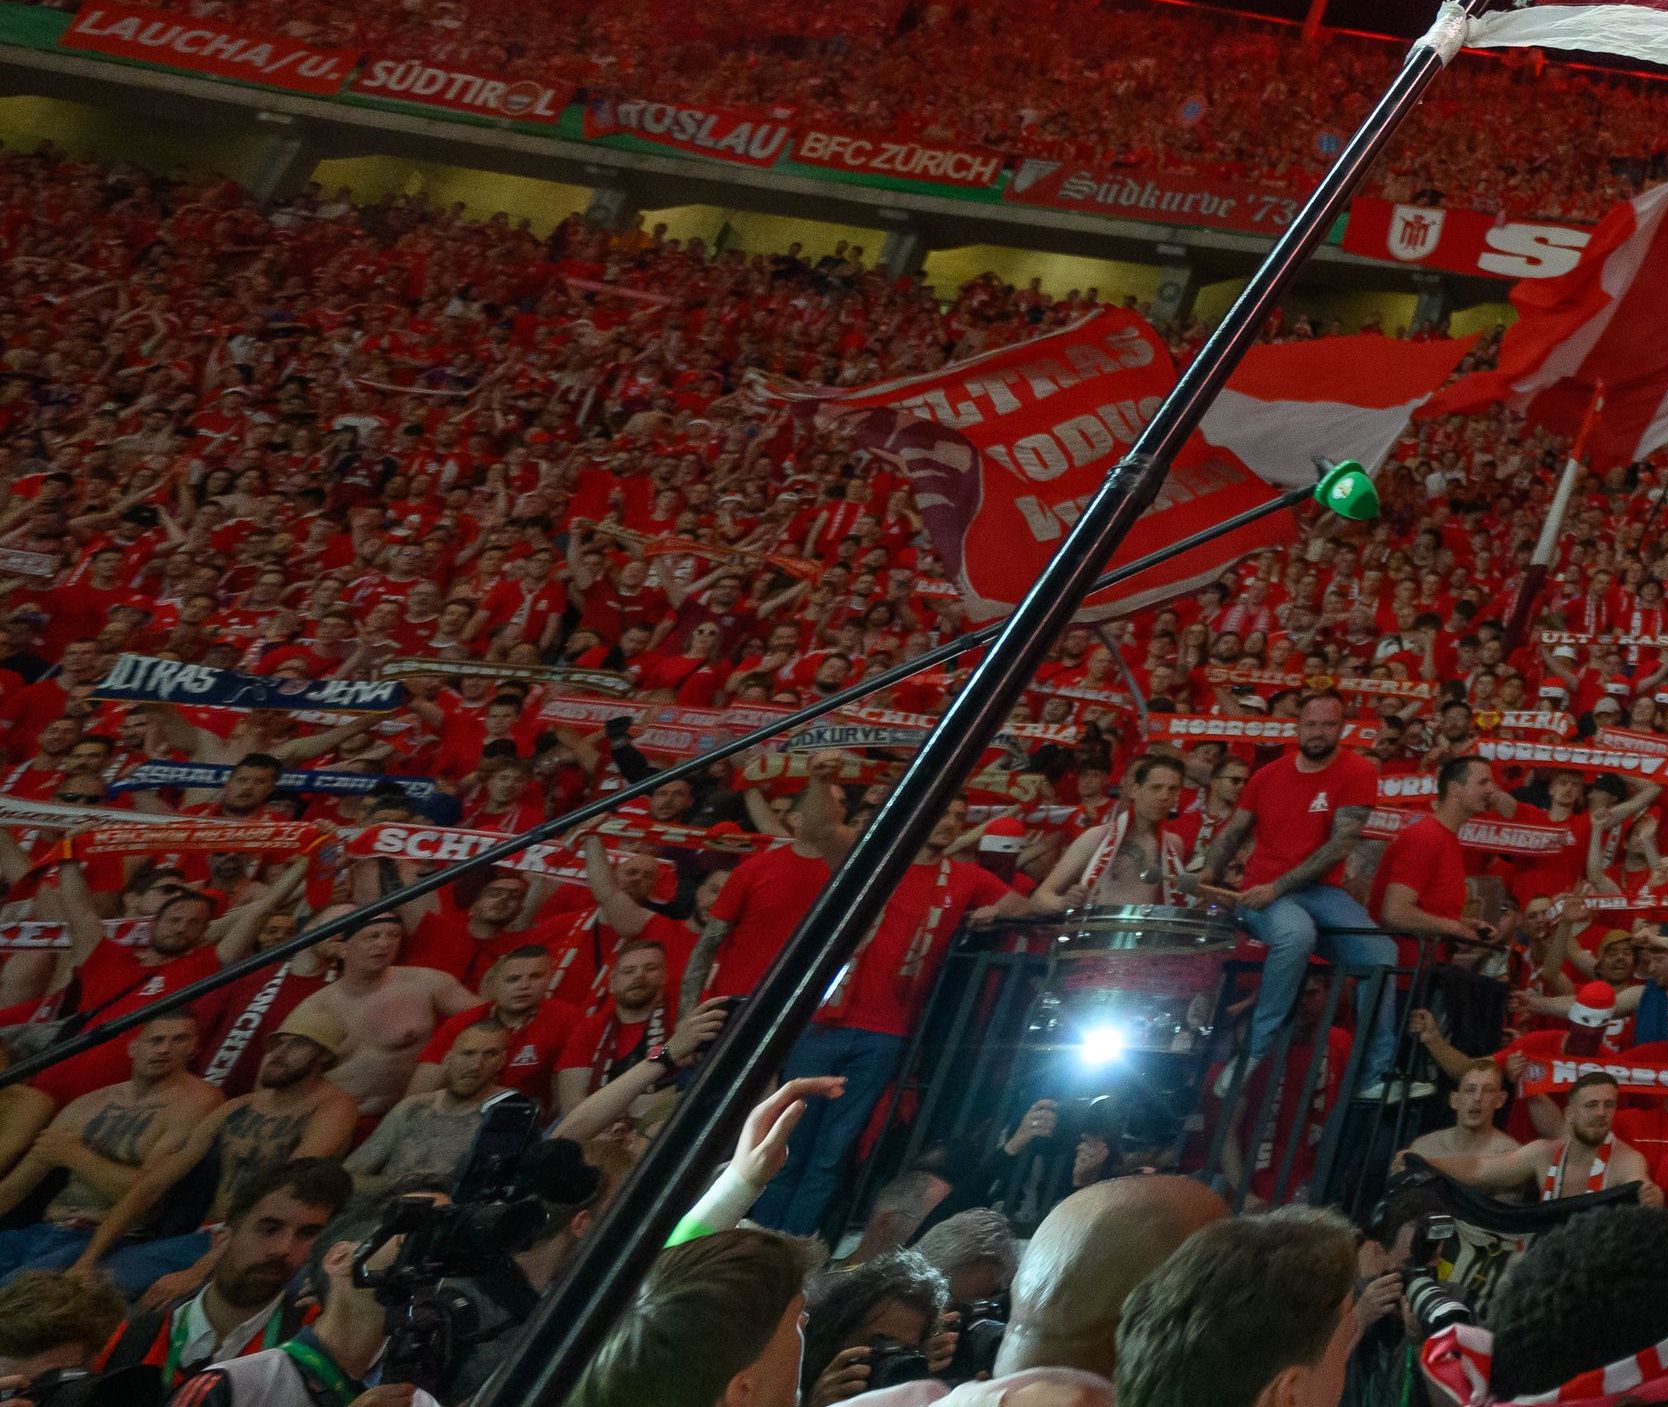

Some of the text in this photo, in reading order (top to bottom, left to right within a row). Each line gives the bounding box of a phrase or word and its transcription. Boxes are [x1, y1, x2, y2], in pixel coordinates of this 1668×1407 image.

[73, 10, 342, 80] LAUCHA/U.
[800, 130, 1000, 184] BFC ZÜRICH
